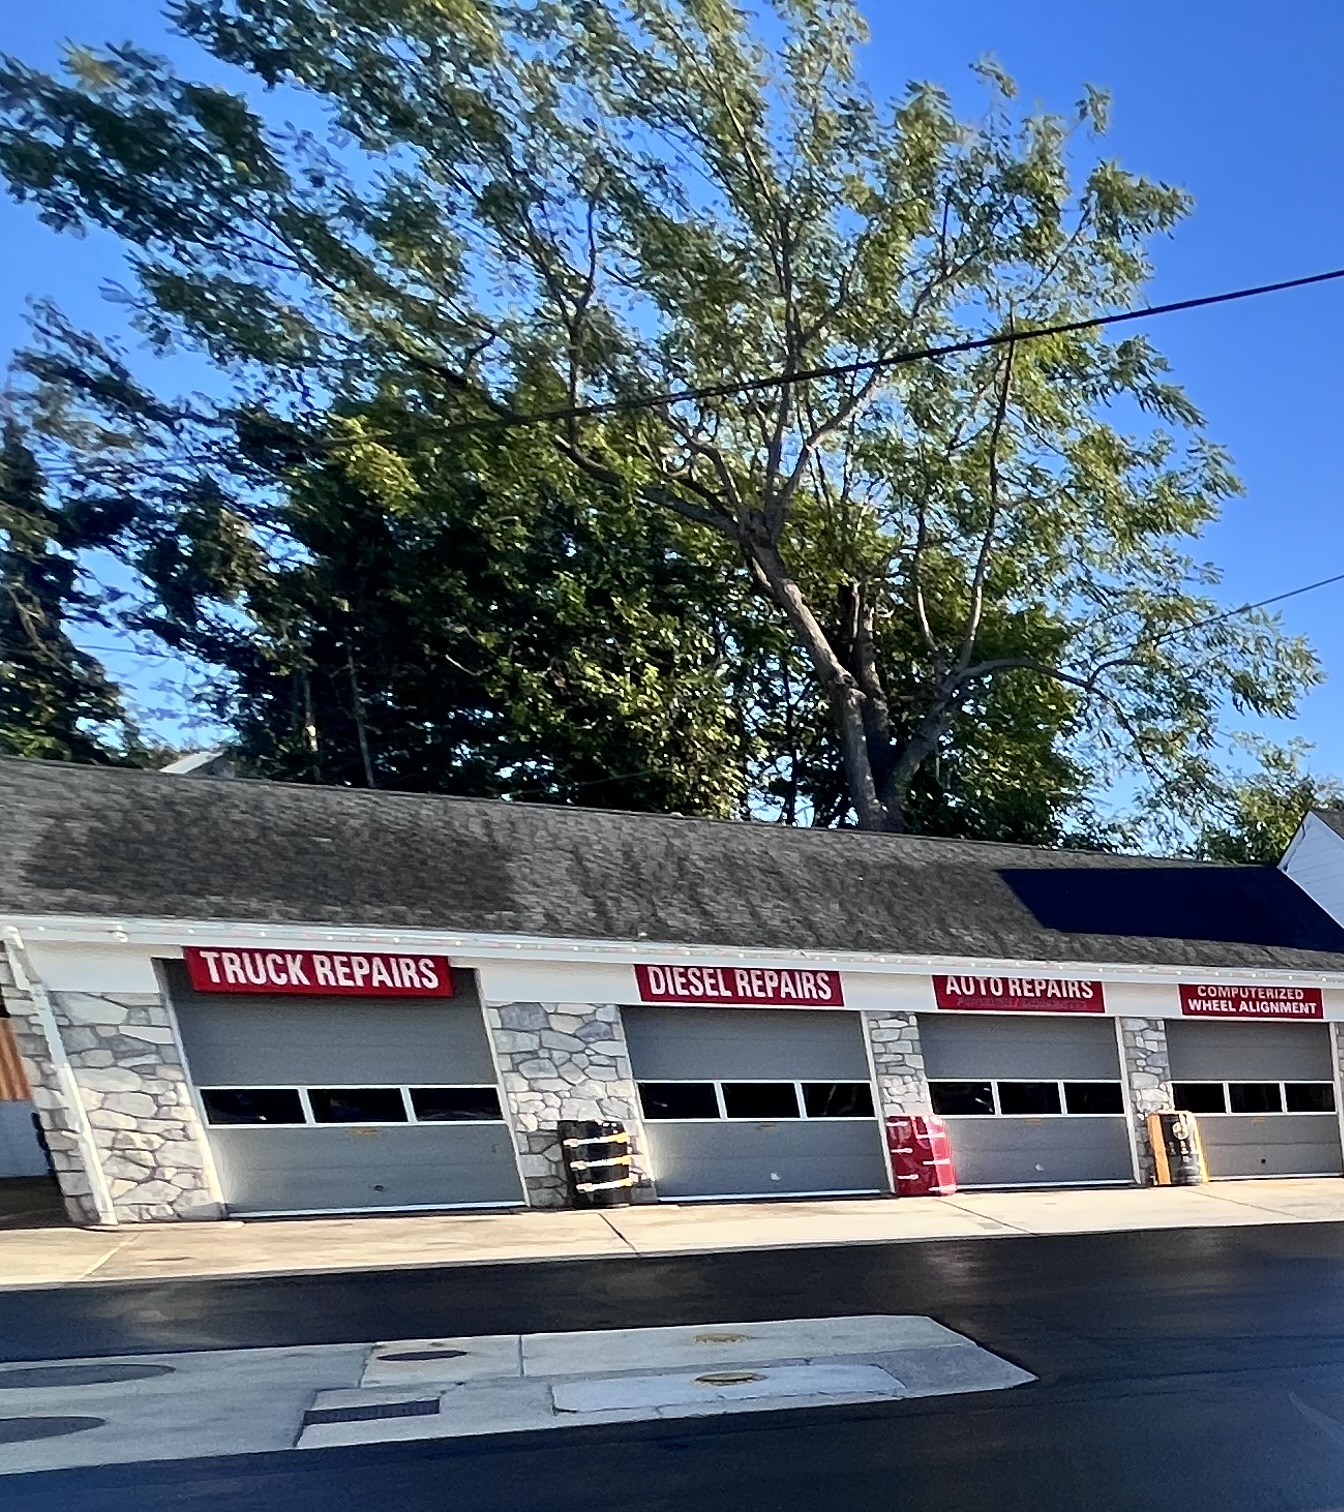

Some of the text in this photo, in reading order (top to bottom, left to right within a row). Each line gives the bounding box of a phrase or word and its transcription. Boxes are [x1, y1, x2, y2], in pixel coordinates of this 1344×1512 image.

[199, 950, 440, 990] TRUCK REPAIRS
[647, 966, 832, 1000] DIESEL REPAIRS
[946, 975, 1094, 998] AUTO REPAIRS
[1197, 985, 1304, 1000] COMPUTERIZED
[1188, 999, 1317, 1014] WHEEL ALIGNMENT
